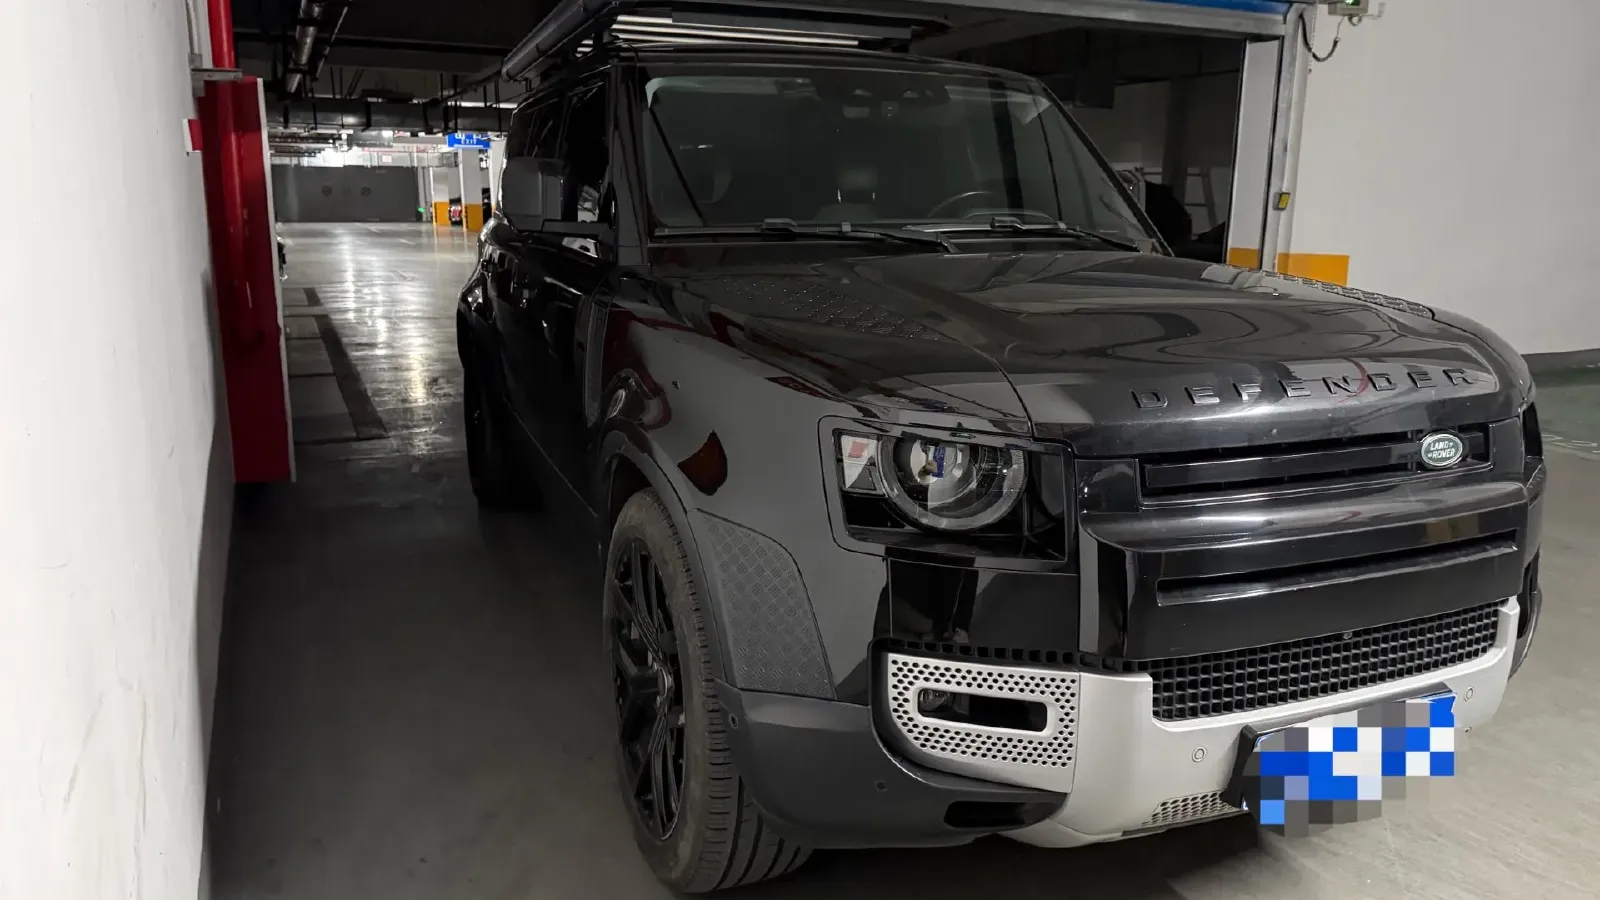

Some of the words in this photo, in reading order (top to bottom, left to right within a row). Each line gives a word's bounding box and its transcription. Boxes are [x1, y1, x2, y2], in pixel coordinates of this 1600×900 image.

[1131, 368, 1473, 408] DEFENDER
[1430, 441, 1449, 451] LAND
[1432, 448, 1456, 459] ROVER
